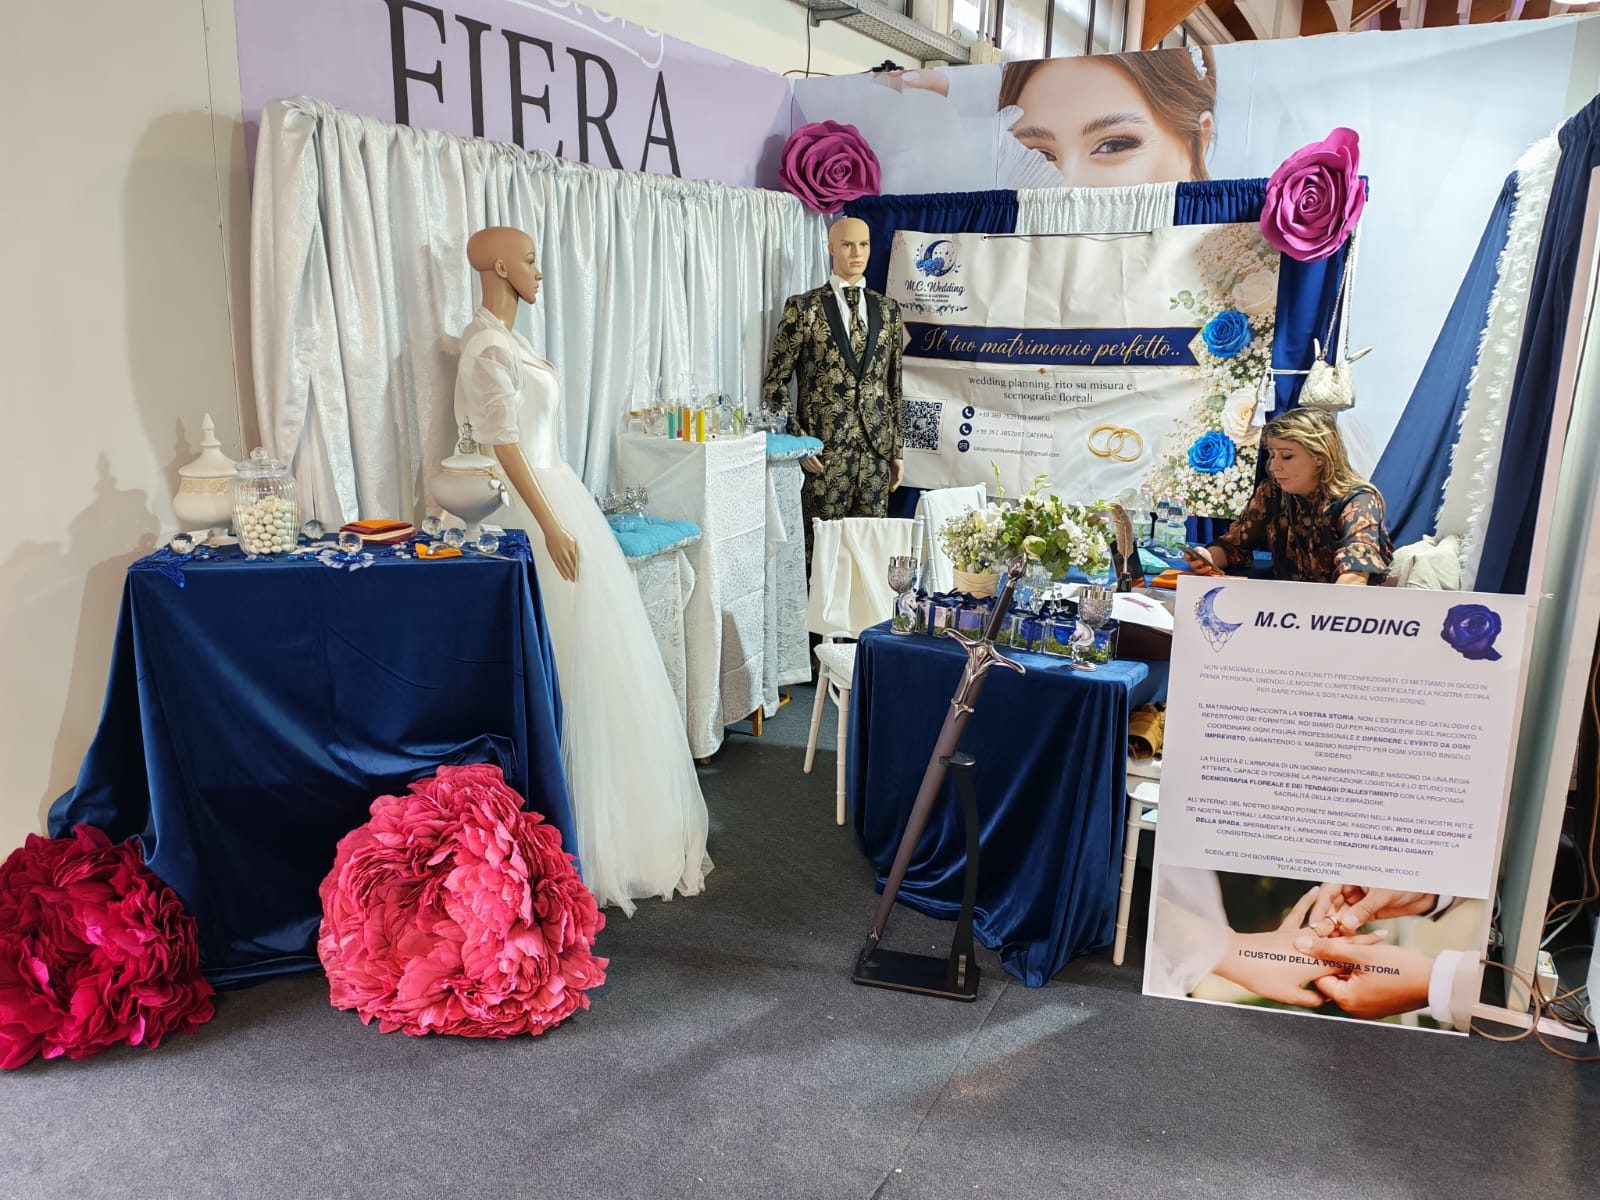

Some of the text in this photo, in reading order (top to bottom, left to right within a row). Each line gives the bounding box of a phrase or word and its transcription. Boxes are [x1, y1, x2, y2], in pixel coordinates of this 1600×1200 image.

[927, 281, 965, 296] Wedding
[921, 327, 944, 352] Il
[949, 337, 976, 353] tuo
[979, 332, 1092, 358] matrimonio
[969, 377, 1006, 388] wedding
[1055, 382, 1072, 390] rito
[1090, 382, 1125, 392] misura
[1003, 391, 1056, 402] scenografie
[1254, 611, 1421, 638] M.C. WEDDING
[1244, 950, 1286, 962] CUSTODI
[1289, 956, 1320, 966] DELLA
[1323, 959, 1361, 971] VOSTRA
[1364, 964, 1400, 976] STORIA
